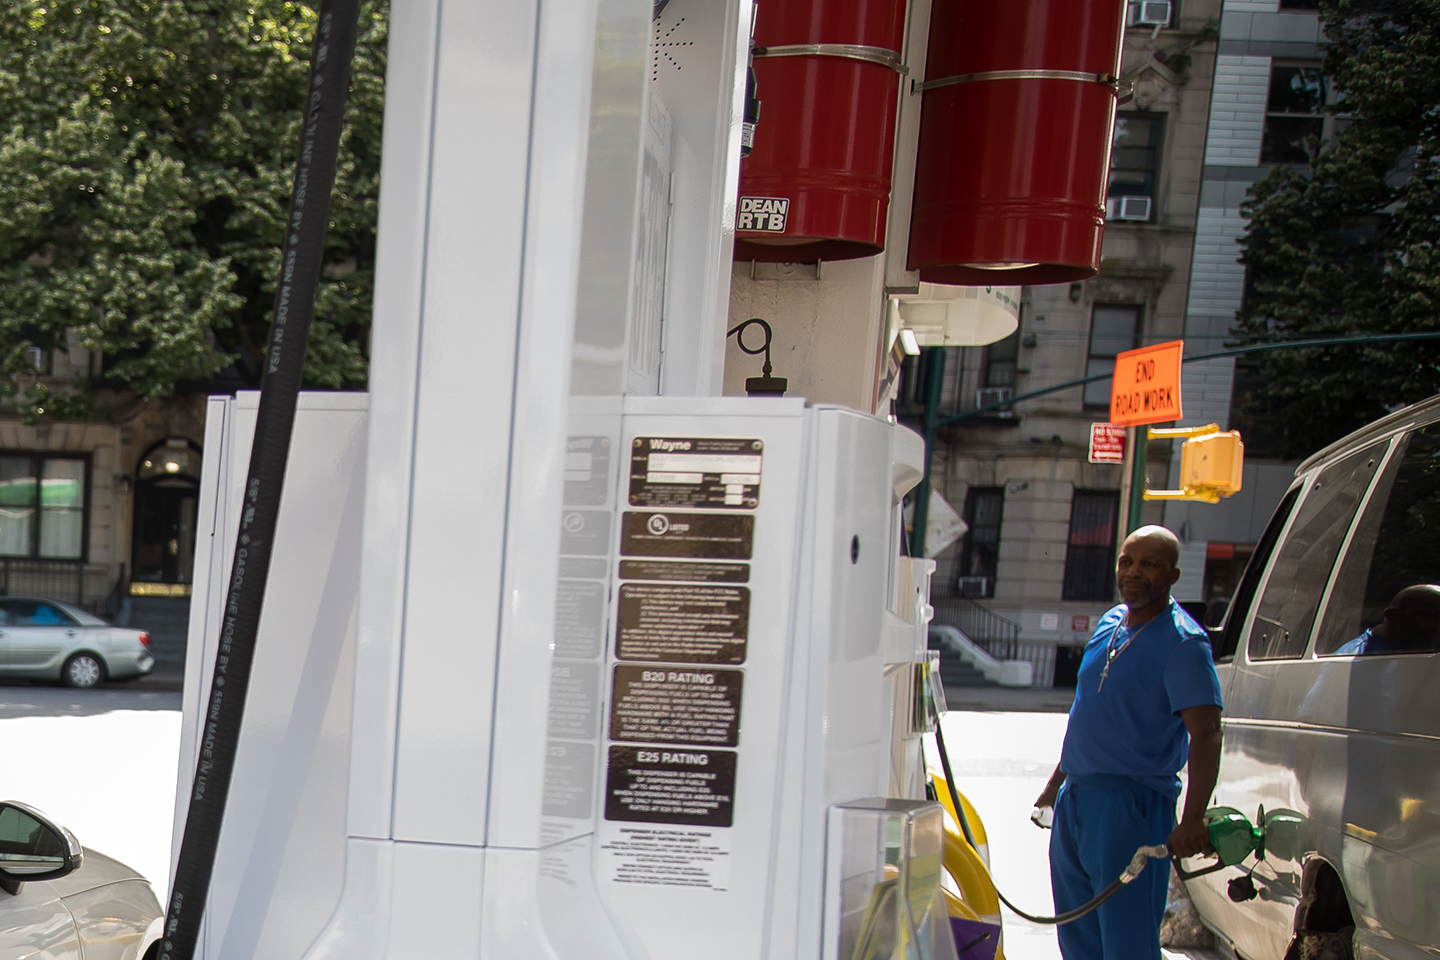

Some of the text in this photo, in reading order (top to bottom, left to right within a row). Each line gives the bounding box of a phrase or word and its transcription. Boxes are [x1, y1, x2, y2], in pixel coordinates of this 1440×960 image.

[294, 168, 310, 207] HOSE
[740, 199, 787, 214] DEAN
[292, 212, 303, 230] BY
[738, 213, 783, 230] RTB
[283, 251, 297, 283] 559N
[276, 285, 292, 325] MADE
[273, 328, 284, 342] IN
[268, 349, 281, 374] USA
[1135, 358, 1155, 384] END
[1115, 386, 1174, 417] ROAD WORK
[649, 439, 691, 452] Wayne
[669, 523, 690, 531] LISTED
[228, 548, 249, 615] GASOLINE
[222, 616, 236, 653] HOSE
[218, 656, 229, 674] BY
[642, 670, 714, 684] B20 RATING
[203, 721, 218, 757] MADE
[200, 759, 211, 773] IN
[636, 751, 708, 765] E25 RATING
[194, 776, 208, 800] USA
